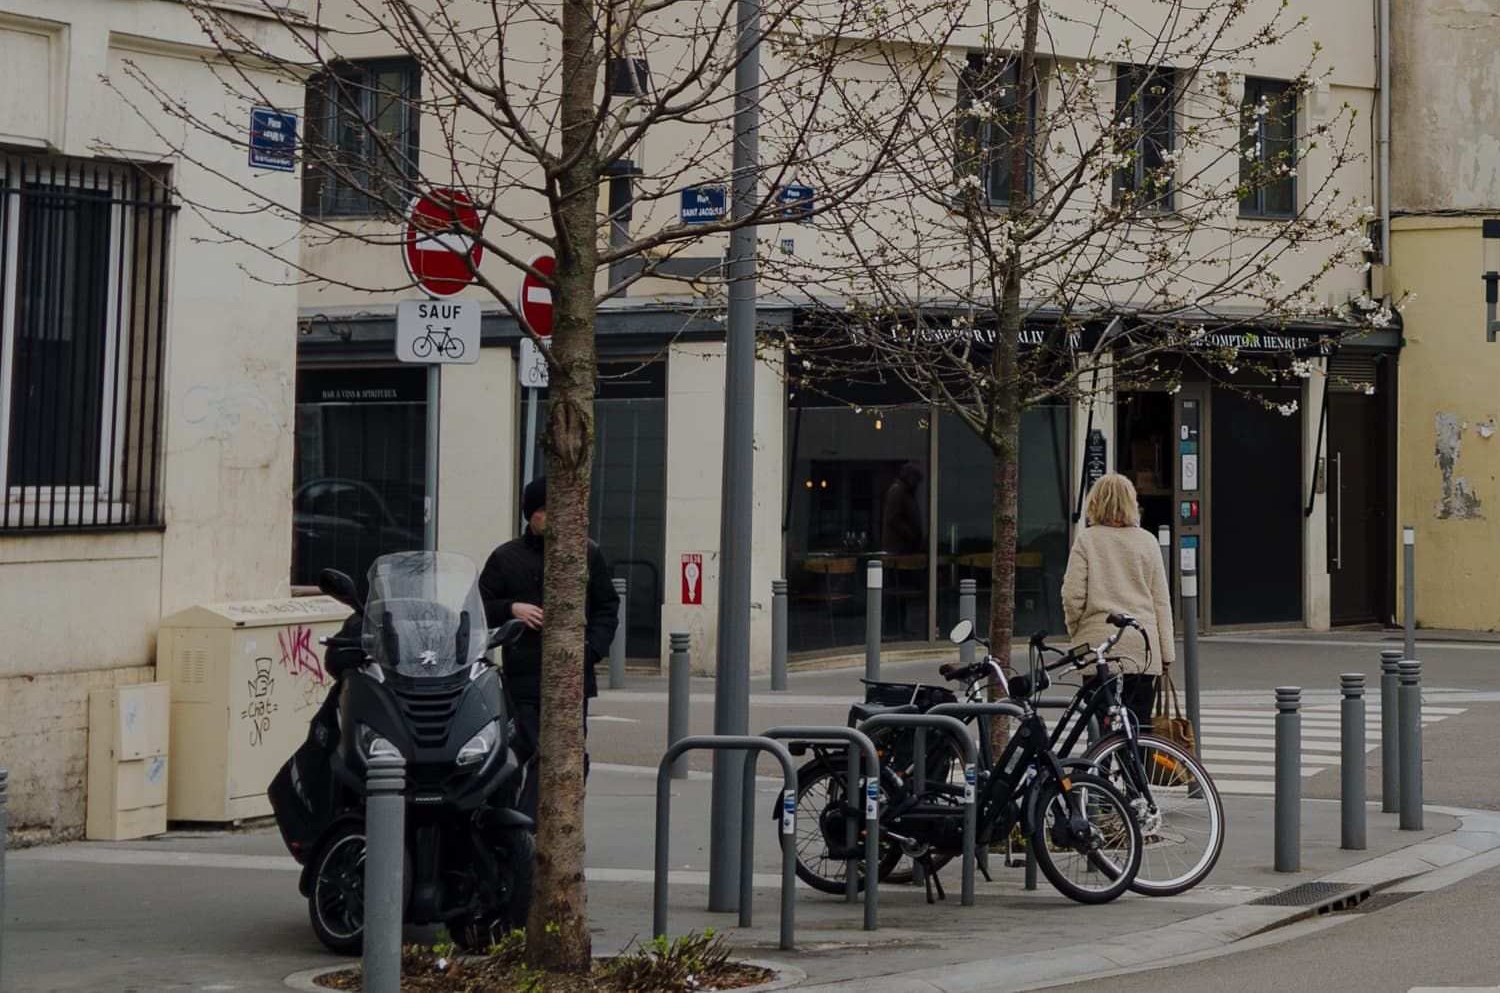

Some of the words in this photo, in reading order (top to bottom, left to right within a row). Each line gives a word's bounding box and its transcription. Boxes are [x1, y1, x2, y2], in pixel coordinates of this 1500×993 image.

[682, 208, 698, 217] SAINT
[418, 304, 462, 320] SAUF
[1263, 335, 1296, 350] HENRI
